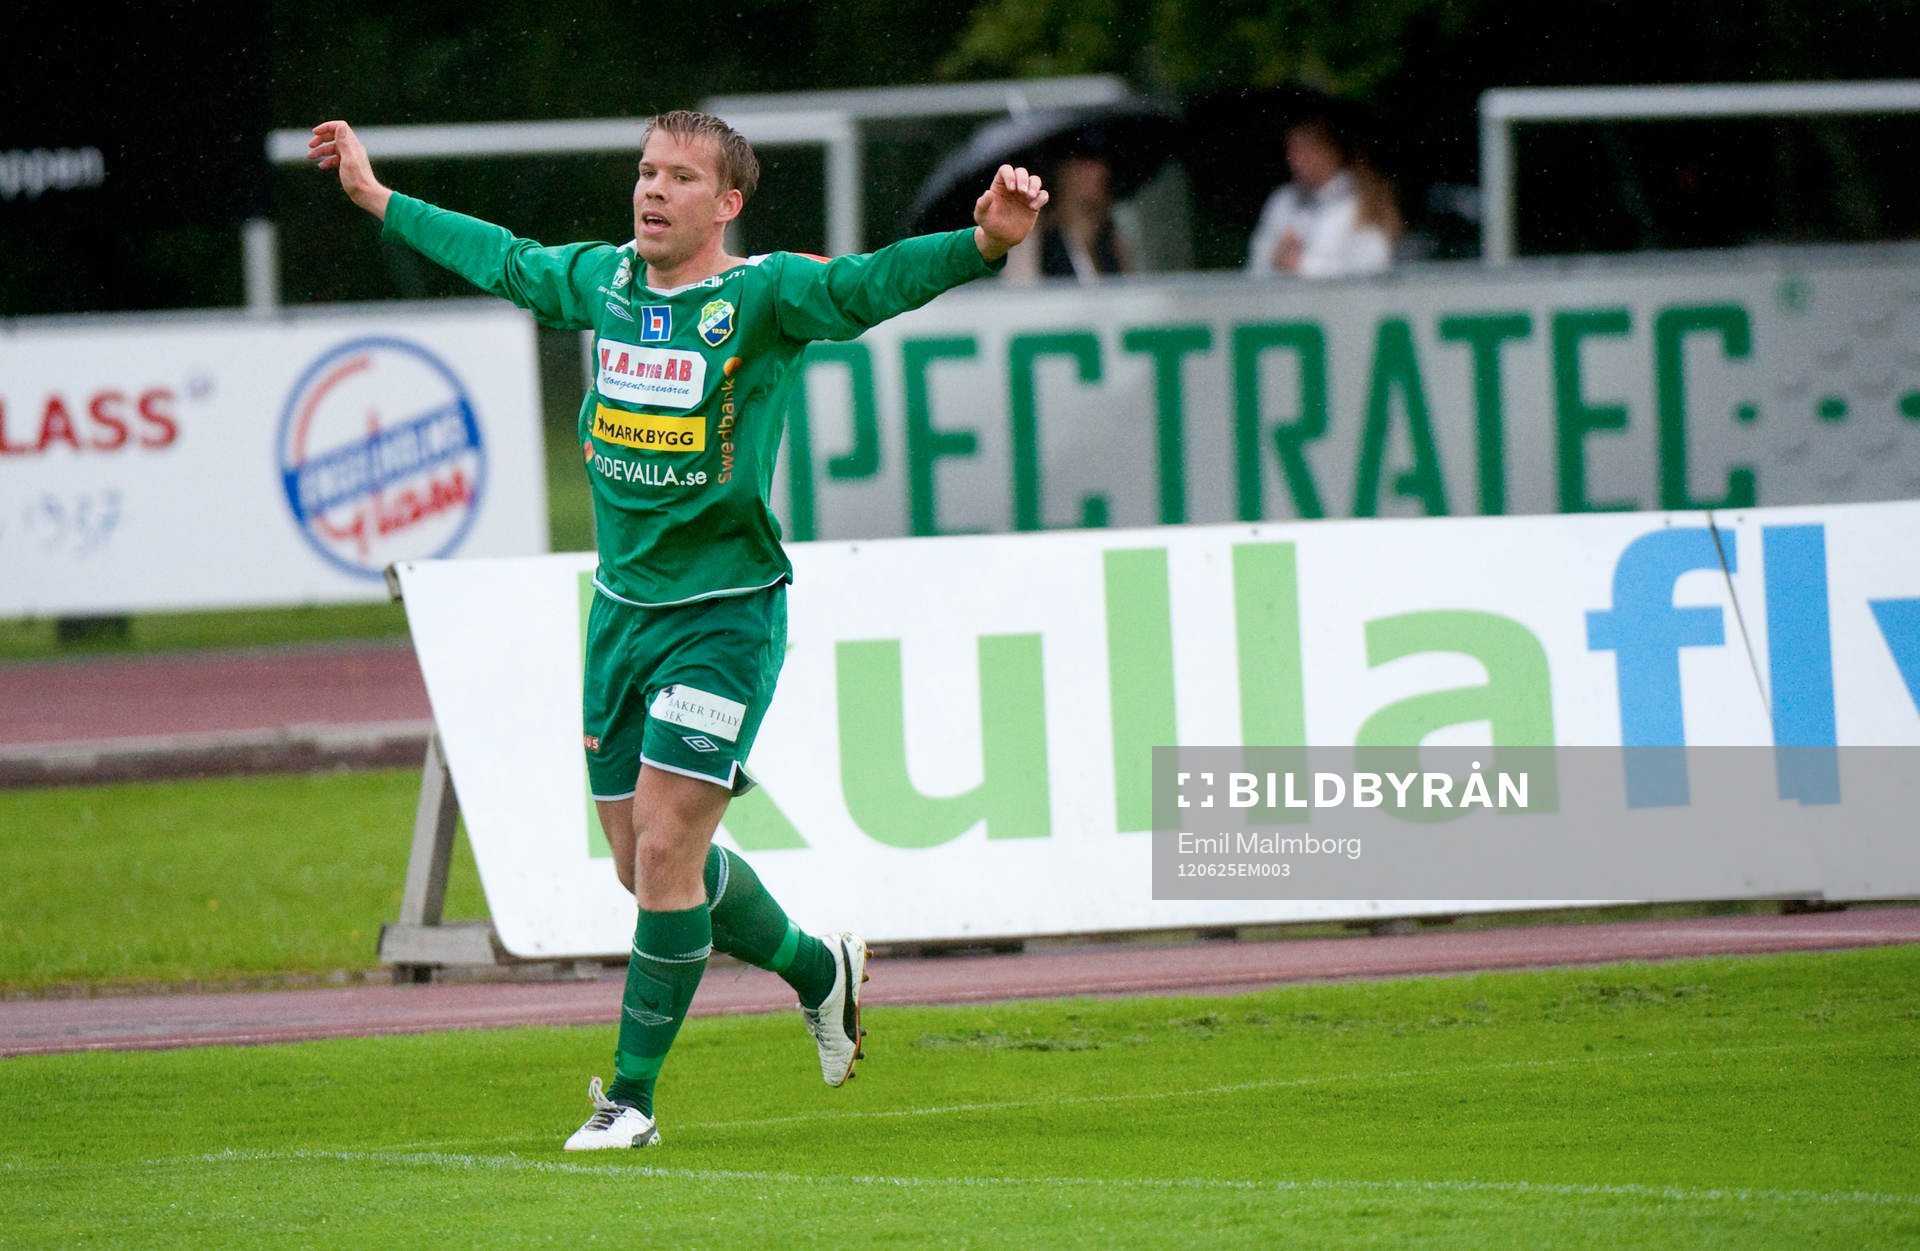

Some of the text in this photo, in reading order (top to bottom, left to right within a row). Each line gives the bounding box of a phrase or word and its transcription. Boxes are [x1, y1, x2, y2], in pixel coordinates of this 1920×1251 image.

[664, 357, 693, 382] AB
[0, 386, 181, 455] LASS
[717, 377, 735, 485] Swedbank
[594, 453, 708, 487] DDEVALLA.se
[710, 708, 740, 727] TILLY
